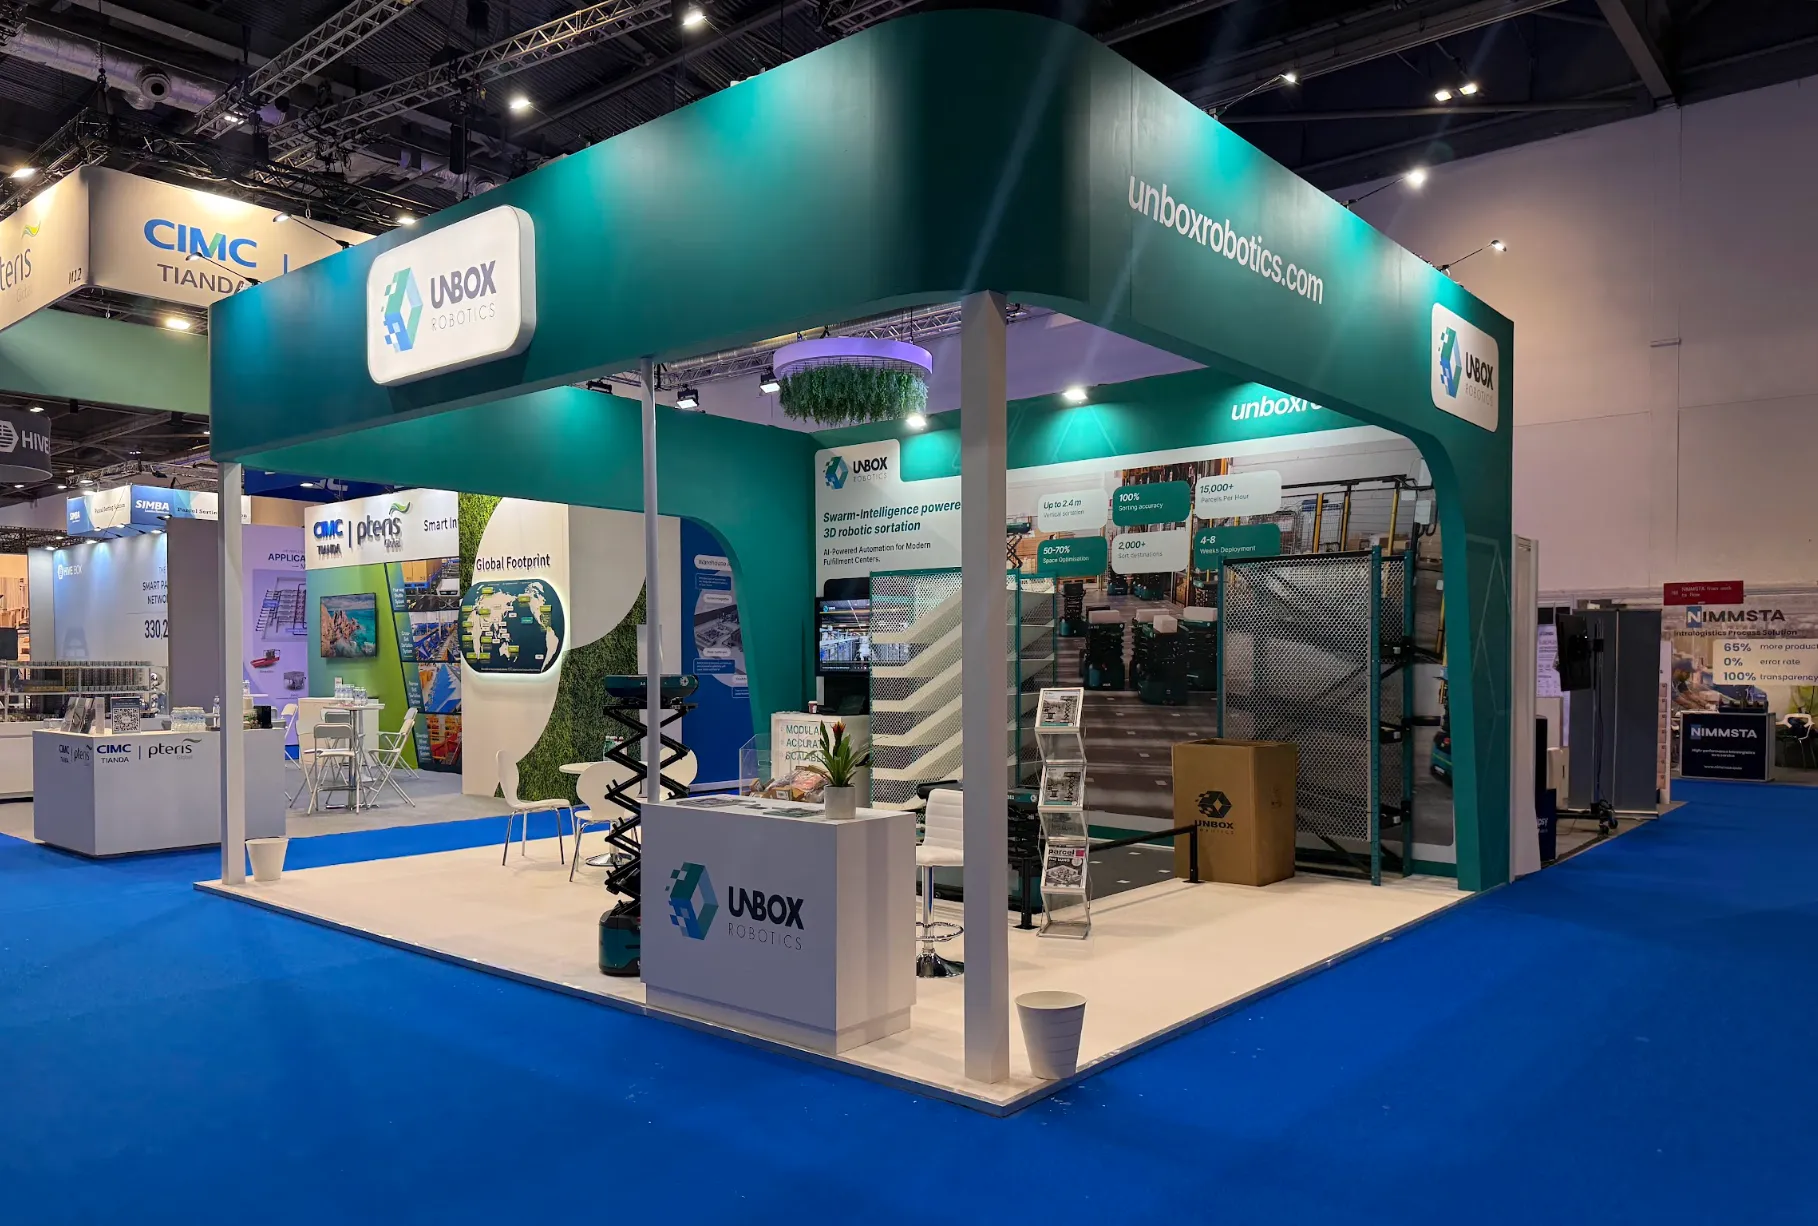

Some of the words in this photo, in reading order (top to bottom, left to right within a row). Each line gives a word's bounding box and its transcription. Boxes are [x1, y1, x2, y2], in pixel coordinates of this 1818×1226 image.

[144, 219, 257, 268] CIMC
[1128, 175, 1324, 305] unboxrobotics.com
[430, 260, 497, 309] UNBOX
[431, 302, 496, 332] ROBOTICS
[1465, 352, 1494, 391] UNBOX
[853, 456, 888, 474] UNBOX
[1200, 483, 1234, 495] 15,000+
[1119, 492, 1140, 502] 100%
[1223, 494, 1234, 502] Per
[1235, 493, 1249, 501] Hour
[135, 499, 170, 511] SIMBA
[1043, 500, 1053, 511] Up
[1054, 501, 1061, 509] to
[1062, 499, 1074, 508] 2.4
[1074, 499, 1082, 507] m
[1118, 504, 1139, 513] Sorting
[1140, 501, 1163, 512] accuracy
[823, 504, 919, 523] Swarm-Intelligence
[423, 518, 448, 532] Smart
[823, 527, 837, 539] 3D
[838, 524, 872, 538] robotic
[874, 520, 921, 534] sortation
[1118, 540, 1146, 550] 2,000+
[1200, 535, 1216, 545] 4-8
[823, 546, 858, 556] AI-Powered
[858, 544, 895, 554] Automation
[895, 543, 904, 551] for
[905, 541, 931, 551] Modern
[1220, 545, 1256, 555] Deployment
[476, 556, 504, 571] Global
[506, 553, 551, 573] Footprint
[854, 555, 881, 565] Centers.
[1043, 556, 1058, 565] Space
[142, 581, 159, 591] SMART
[147, 594, 168, 605] NETWO
[1687, 609, 1786, 624] NIMMSTA
[1674, 628, 1727, 638] Intralogistics
[1762, 628, 1798, 637] Solution
[1724, 643, 1751, 652] 65%
[1724, 657, 1743, 666] 0%
[1724, 672, 1756, 681] 100%
[1690, 727, 1757, 738] NIMMSTA
[97, 743, 132, 754] CIMC
[148, 743, 193, 759] pteris
[101, 756, 130, 764] TIANDA
[728, 886, 805, 931] UNBOX
[728, 922, 802, 951] ROBOTICS
